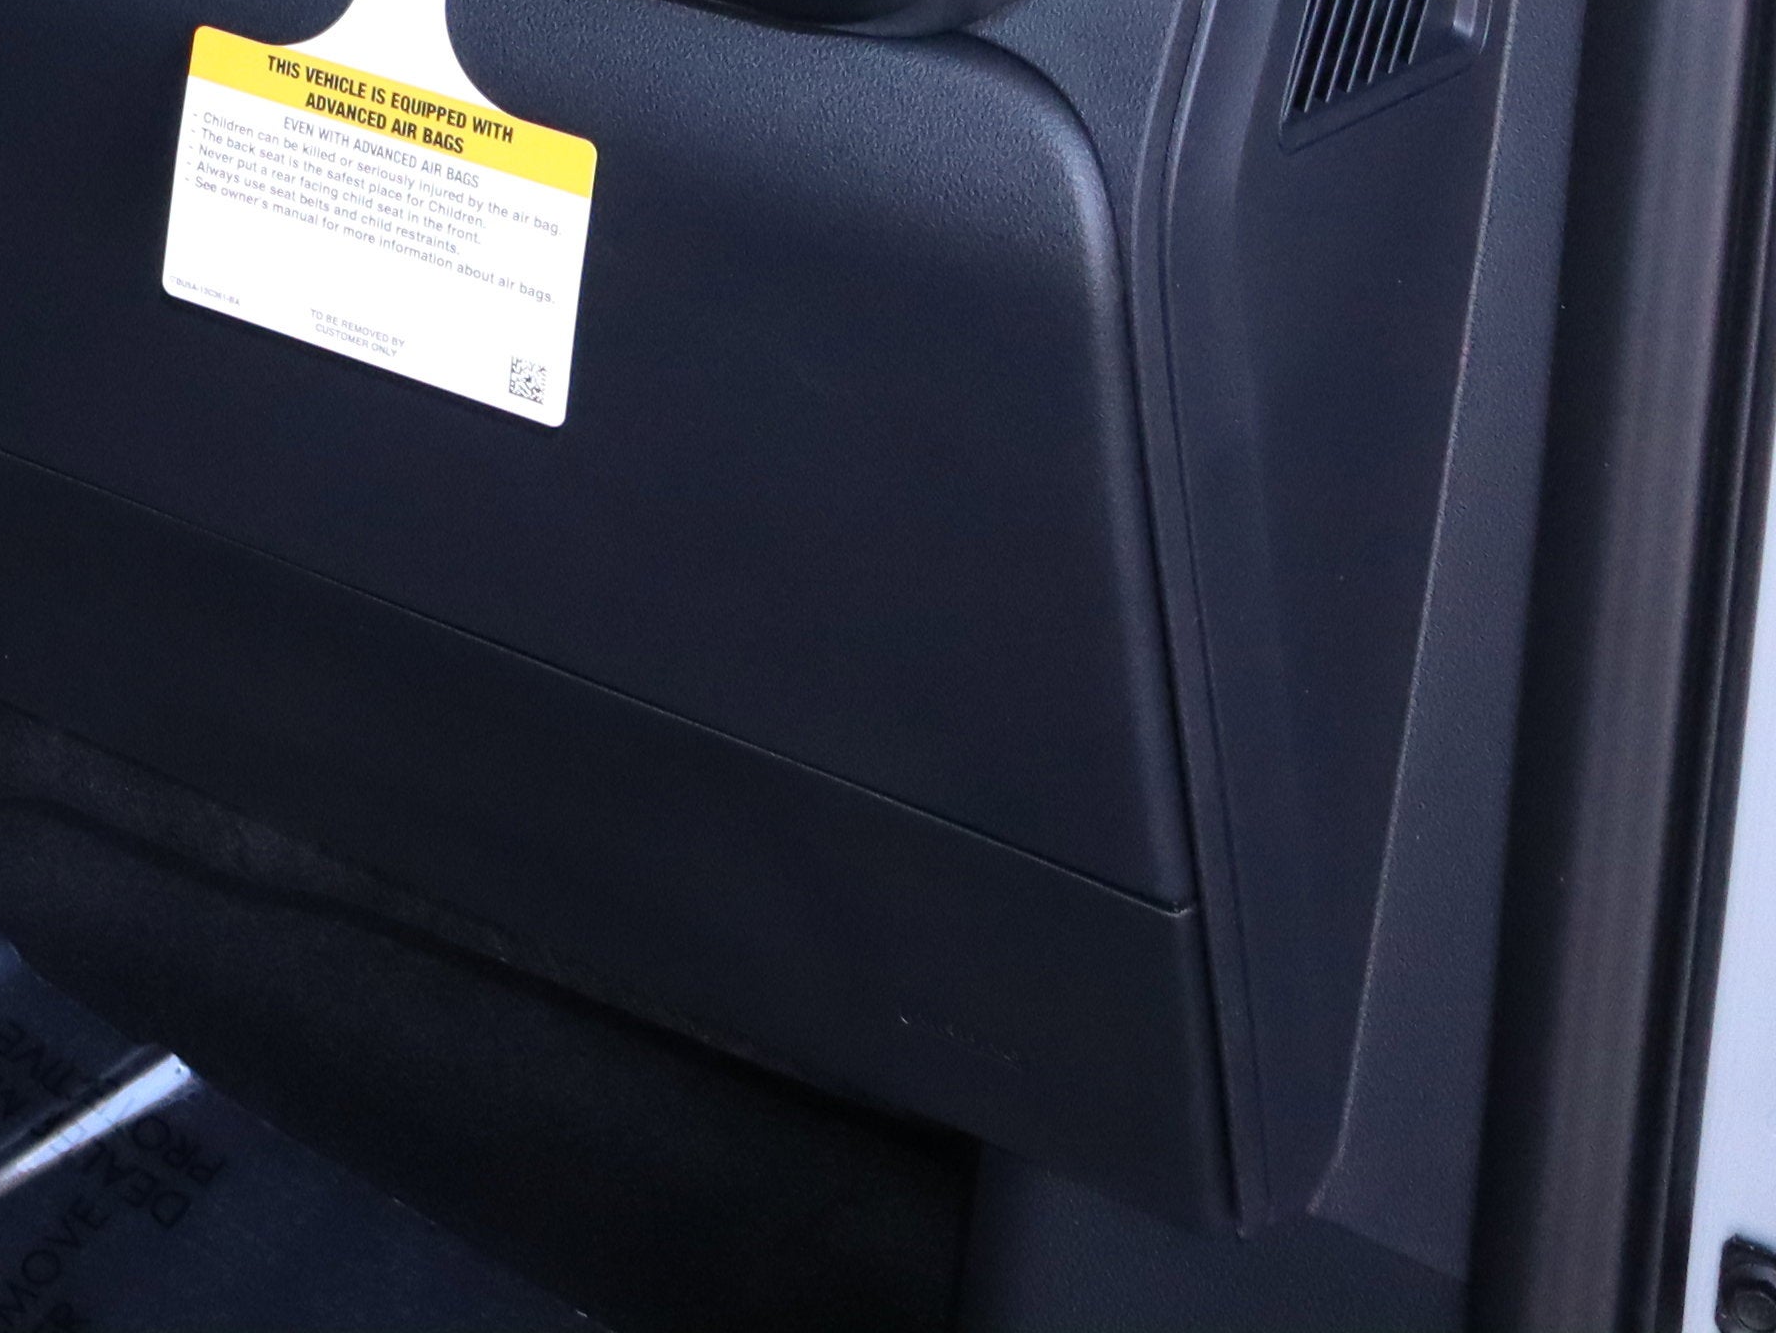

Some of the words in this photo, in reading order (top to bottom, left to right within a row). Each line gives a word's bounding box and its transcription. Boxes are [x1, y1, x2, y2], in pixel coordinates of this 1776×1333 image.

[267, 54, 301, 80] THIS
[305, 65, 367, 100] VEHICLE
[370, 85, 386, 105] IS
[390, 91, 467, 129] EQUIPPED
[472, 115, 514, 144] WITH
[305, 91, 387, 130] ADVANCED
[390, 117, 418, 140] AIR
[422, 126, 465, 154] BAGS
[198, 143, 235, 164] Never
[236, 158, 258, 173] put
[271, 169, 297, 185] rear
[299, 175, 339, 201] facing
[342, 190, 374, 210] child
[376, 202, 404, 220] seat
[407, 209, 420, 224] in
[423, 215, 444, 233] the
[447, 222, 481, 245] front.
[202, 127, 224, 145] The
[226, 135, 256, 156] back
[258, 148, 286, 166] seat
[288, 155, 300, 169] is
[303, 160, 323, 177] the
[326, 169, 365, 190] safest
[368, 182, 403, 202] place
[406, 192, 425, 208] for
[428, 199, 487, 229] Children.
[203, 111, 254, 138] Children
[257, 131, 280, 146] can
[283, 136, 299, 152] be
[301, 142, 337, 164] killed
[339, 156, 354, 168] or
[356, 161, 416, 191] seriously
[418, 179, 465, 204] injured
[467, 194, 485, 213] by
[487, 201, 509, 218] the
[511, 211, 530, 224] air
[533, 215, 561, 237] bag.
[283, 116, 315, 137] EVEN
[318, 126, 350, 148] WITH
[352, 138, 418, 169] ADVANCED
[420, 159, 443, 178] AIR
[446, 166, 480, 189] BAGS
[194, 175, 218, 194] See
[272, 203, 319, 226] manual
[322, 216, 340, 232] for
[343, 225, 376, 245] more
[379, 235, 453, 270] information
[456, 263, 495, 285] about
[497, 276, 516, 290] air
[519, 281, 555, 304] bags.
[196, 160, 241, 184] Always
[243, 177, 266, 192] use
[269, 185, 296, 202] seat
[299, 192, 330, 213] belts
[333, 205, 358, 222] and
[360, 214, 393, 233] child
[395, 225, 460, 256] restraints.
[310, 308, 324, 321] TO
[325, 313, 339, 327] BE
[340, 319, 390, 343] REMOVED
[391, 336, 406, 348] BY
[315, 323, 369, 349] CUSTOMER
[370, 342, 398, 358] ONLY
